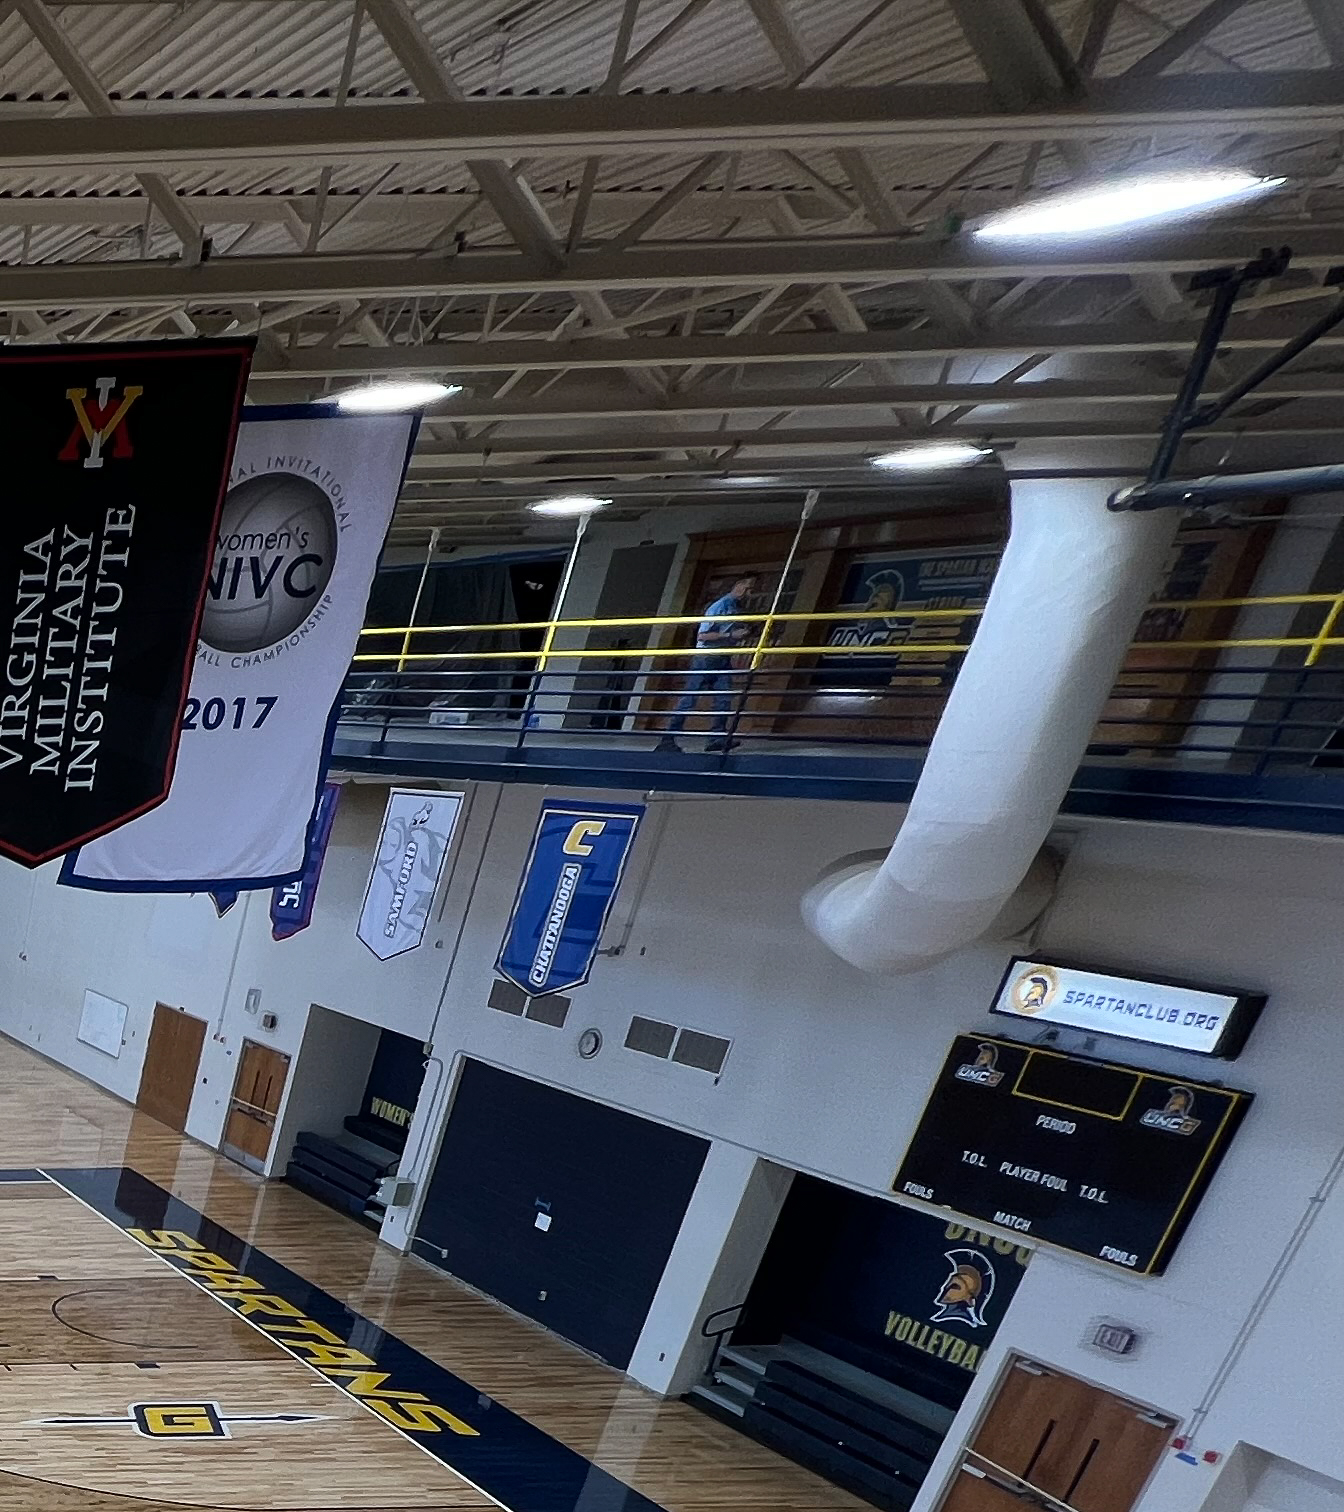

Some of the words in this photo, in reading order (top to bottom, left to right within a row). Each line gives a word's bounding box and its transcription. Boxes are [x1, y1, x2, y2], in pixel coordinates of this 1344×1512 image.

[266, 455, 353, 533] INVITATIONAL
[29, 524, 94, 776] MILITARY
[64, 503, 136, 793] INSTITUTE
[231, 594, 334, 670] CHAMPIONSHIP
[181, 696, 279, 731] 2017
[562, 820, 606, 857] C
[384, 842, 418, 939] SAMFORD
[531, 865, 581, 986] CHATTANOOGA
[957, 1065, 1003, 1086] UNCG
[1035, 1114, 1077, 1135] PERIOD
[1142, 1110, 1200, 1135] UNCG
[903, 1181, 934, 1199] FOULS
[1000, 1161, 1040, 1183] PLAYER
[1040, 1173, 1068, 1191] FOUL
[993, 1211, 1032, 1231] MATCH
[1099, 1245, 1138, 1267] FOULS
[126, 1227, 480, 1436] SPARTANS
[884, 1310, 983, 1373] VOLLEYBA
[139, 1405, 220, 1436] G
